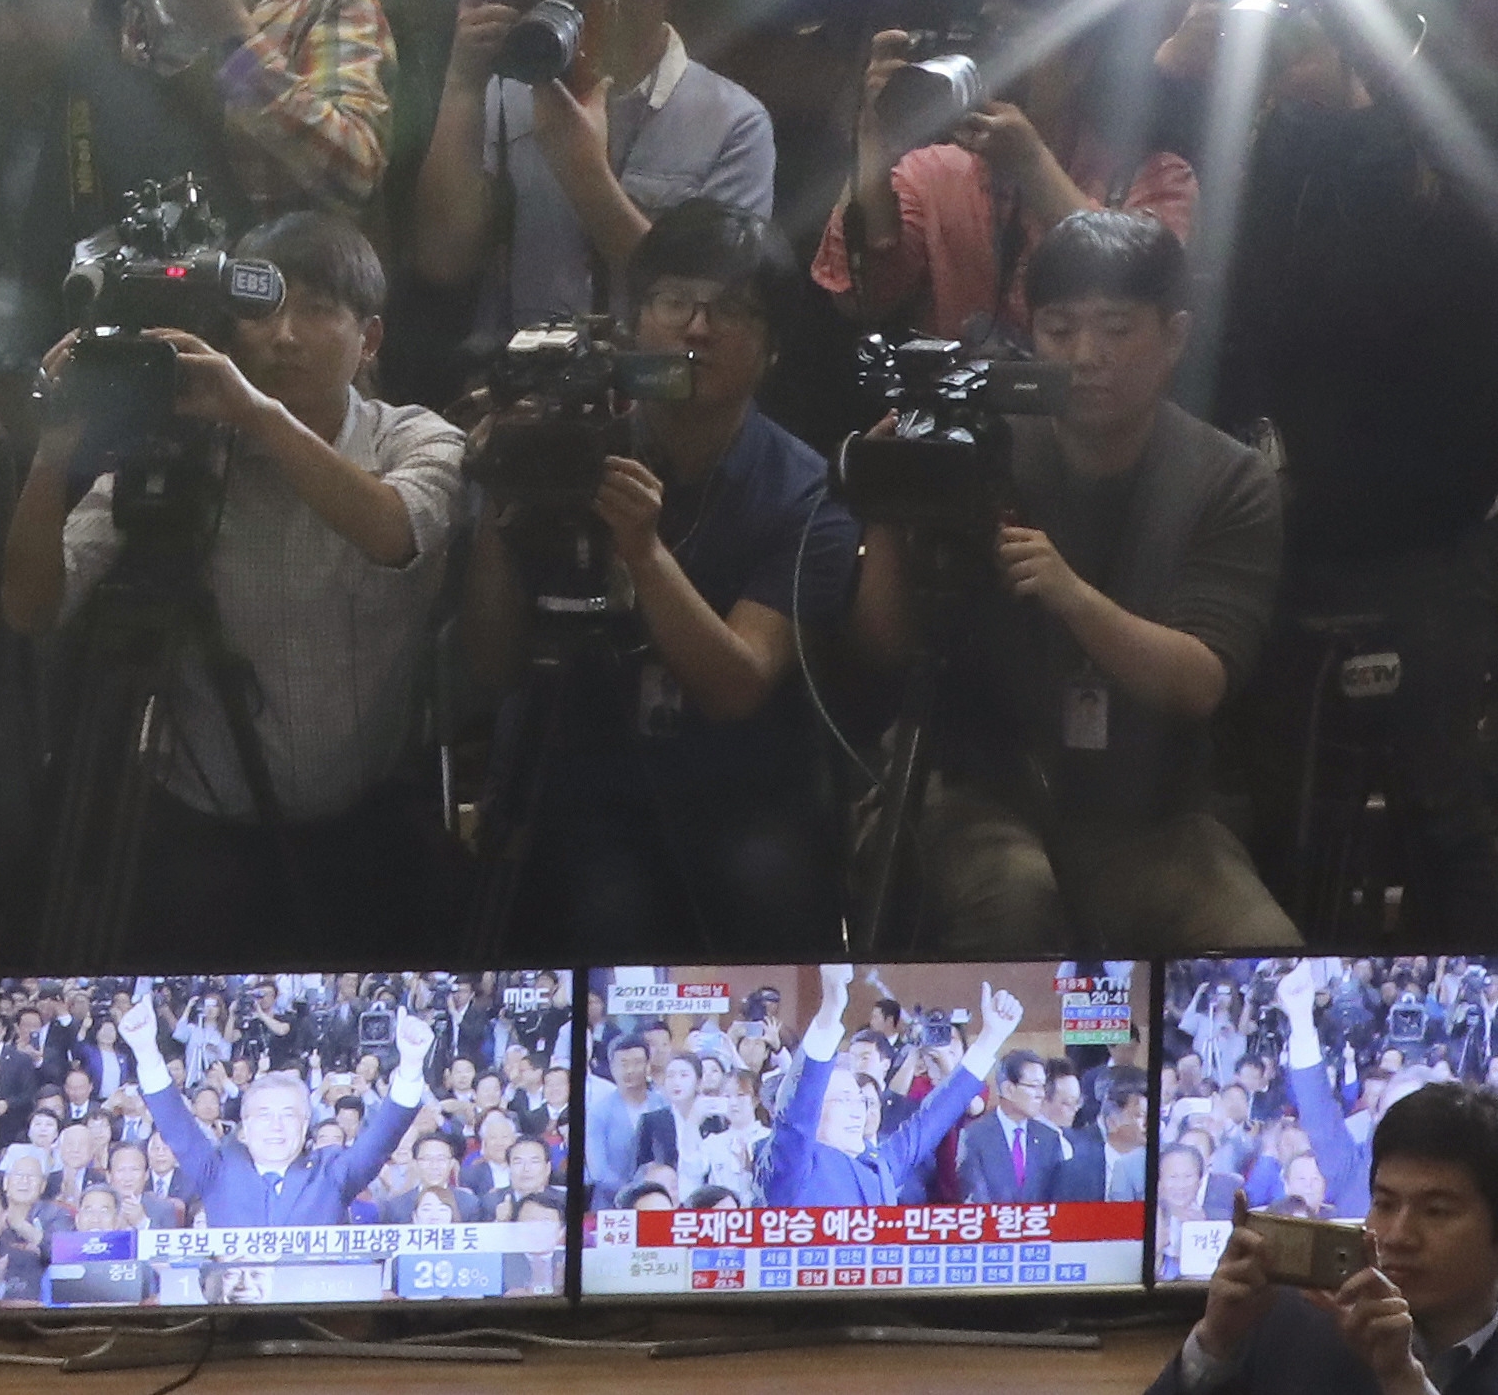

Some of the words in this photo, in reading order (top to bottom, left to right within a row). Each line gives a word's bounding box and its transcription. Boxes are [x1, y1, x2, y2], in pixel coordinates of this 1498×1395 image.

[236, 270, 270, 295] EBS
[614, 986, 646, 997] 2017
[1092, 977, 1131, 991] YTN
[1091, 990, 1129, 1005] 20:41
[603, 1214, 631, 1228] 뉴스
[670, 1210, 754, 1244] 문재인
[760, 1209, 817, 1244] 압승
[990, 1203, 1057, 1240] '환호'
[154, 1232, 172, 1256] 문
[176, 1231, 216, 1258] 후보,
[222, 1230, 240, 1256] 당
[244, 1228, 329, 1255] 상황실에서
[334, 1227, 402, 1253] 개표상황
[406, 1227, 456, 1252] 지켜볼
[462, 1226, 479, 1251] 듯
[603, 1230, 631, 1245] 속보
